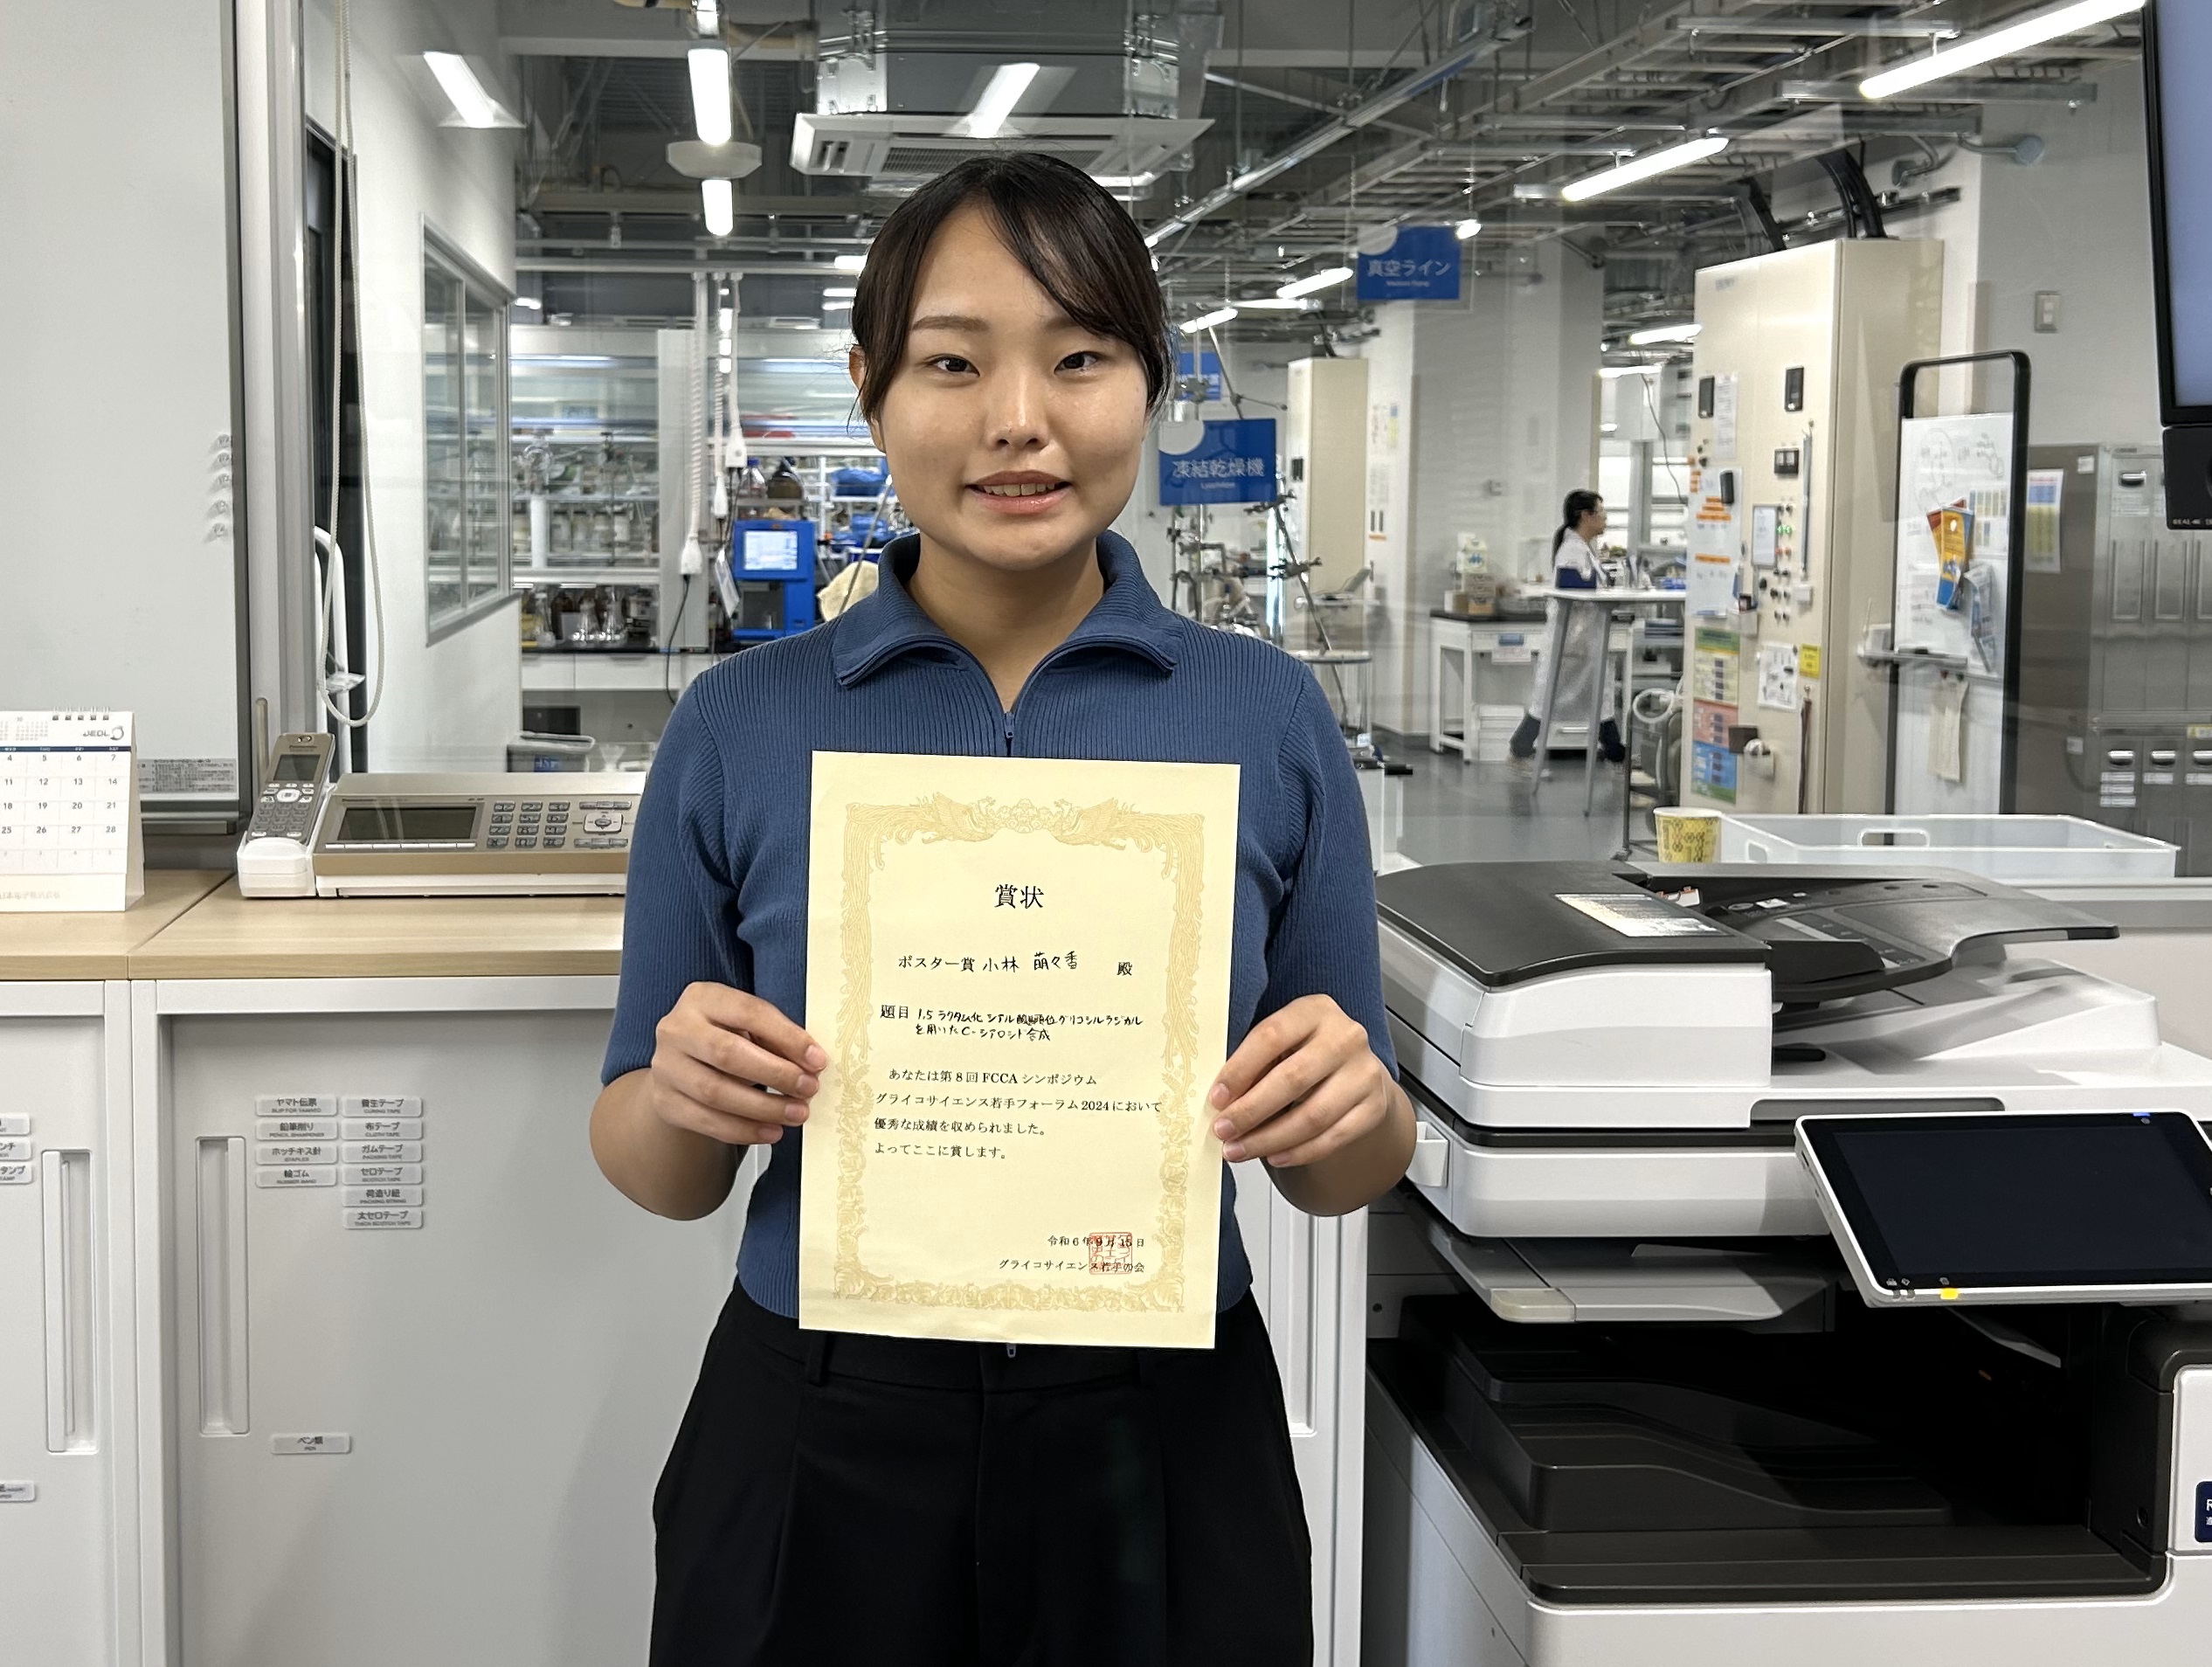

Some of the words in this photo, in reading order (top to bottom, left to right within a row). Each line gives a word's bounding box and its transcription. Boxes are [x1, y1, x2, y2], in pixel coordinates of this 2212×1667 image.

[1367, 259, 1451, 277] 真空ライン
[1172, 457, 1265, 478] 凍結乾燥機
[1, 826, 12, 834] 25
[36, 826, 47, 834] 26
[71, 826, 81, 834] 27
[994, 883, 1045, 910] 賞状
[1116, 961, 1133, 976] 殿
[880, 1004, 909, 1020] 題目
[277, 1097, 317, 1107] ヤマト伝票
[364, 1122, 401, 1131] 布テープ
[874, 1117, 1045, 1136] 優秀な成績を収められました。
[272, 1146, 321, 1156] ホッチキス針
[361, 1144, 404, 1153] ガムテープ
[874, 1141, 1006, 1159] よってここに賞します。
[361, 1166, 404, 1176] セロテープ
